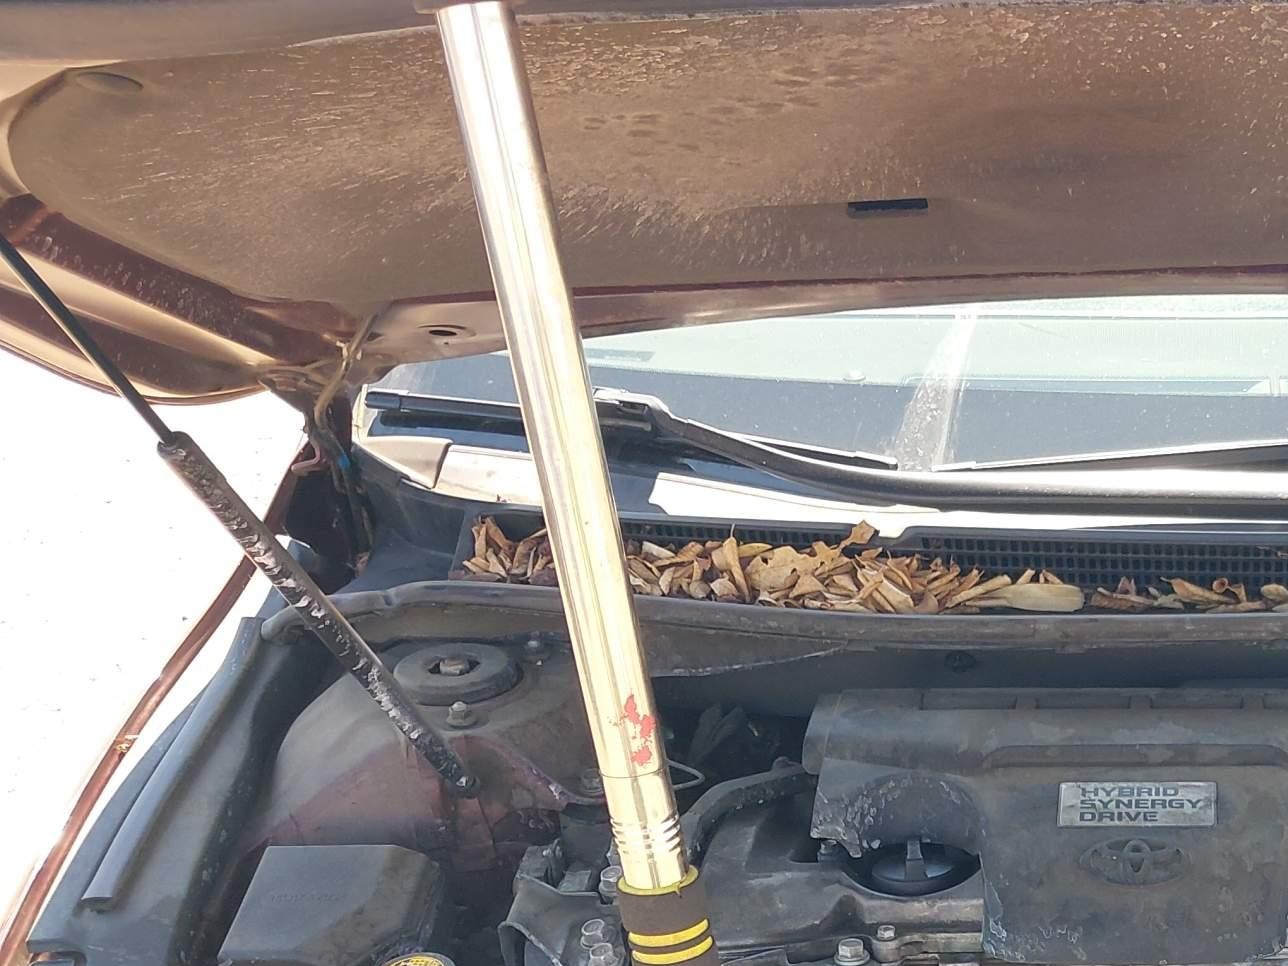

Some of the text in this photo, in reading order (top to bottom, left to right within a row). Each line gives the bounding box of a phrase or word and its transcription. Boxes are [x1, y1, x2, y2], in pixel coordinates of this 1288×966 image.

[1081, 786, 1179, 797] HYBRID
[1080, 798, 1201, 810] SYNERGY
[1080, 811, 1158, 822] DRIVE
